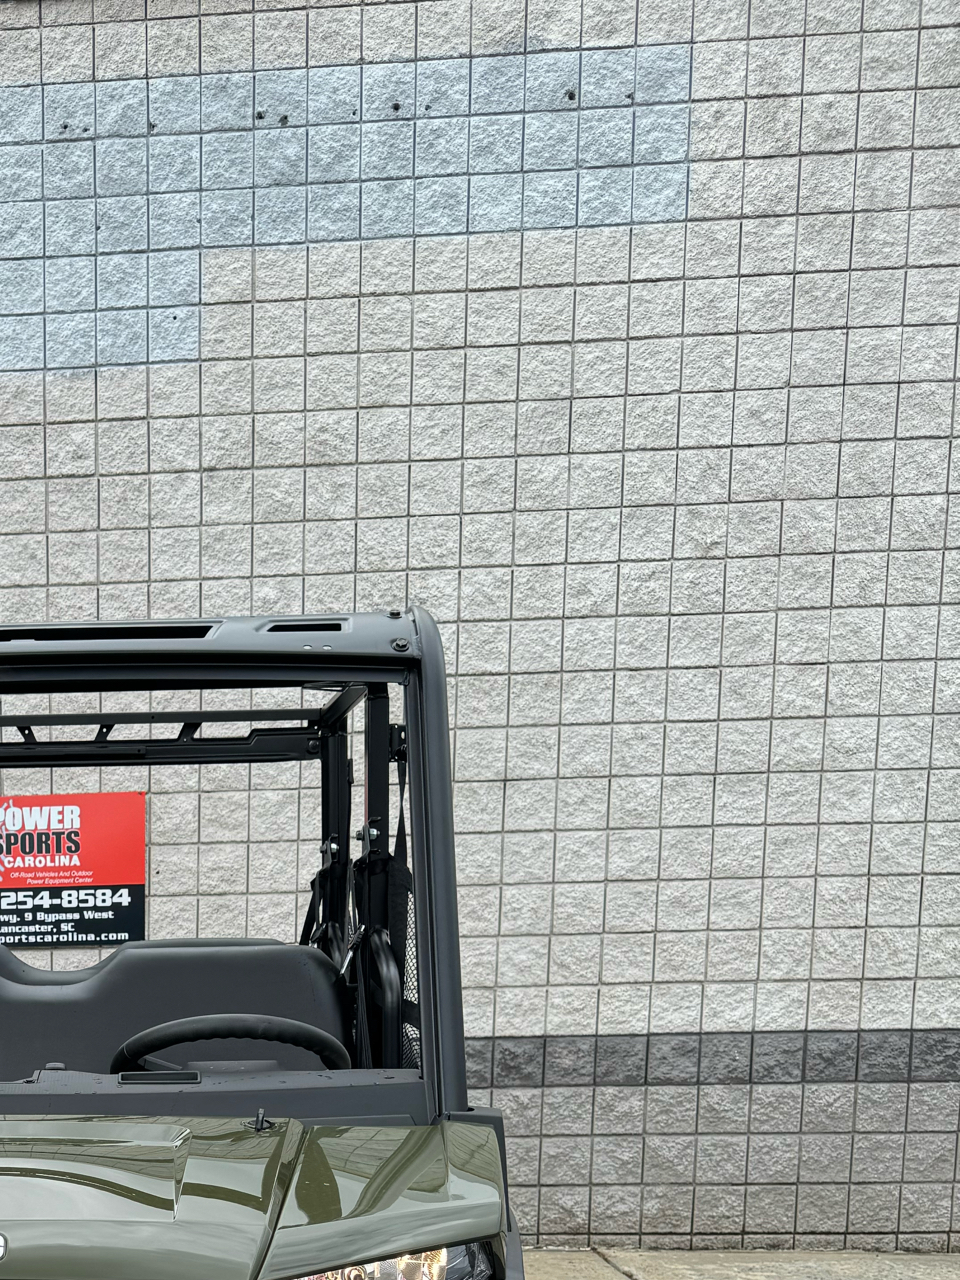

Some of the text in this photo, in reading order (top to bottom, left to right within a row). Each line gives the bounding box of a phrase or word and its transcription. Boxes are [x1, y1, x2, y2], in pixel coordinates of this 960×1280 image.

[4, 855, 81, 868] CAROLINA
[45, 877, 74, 885] Equipment
[24, 912, 33, 921] 9
[36, 911, 80, 922] Bypass
[83, 910, 114, 919] West
[60, 922, 75, 931] SC
